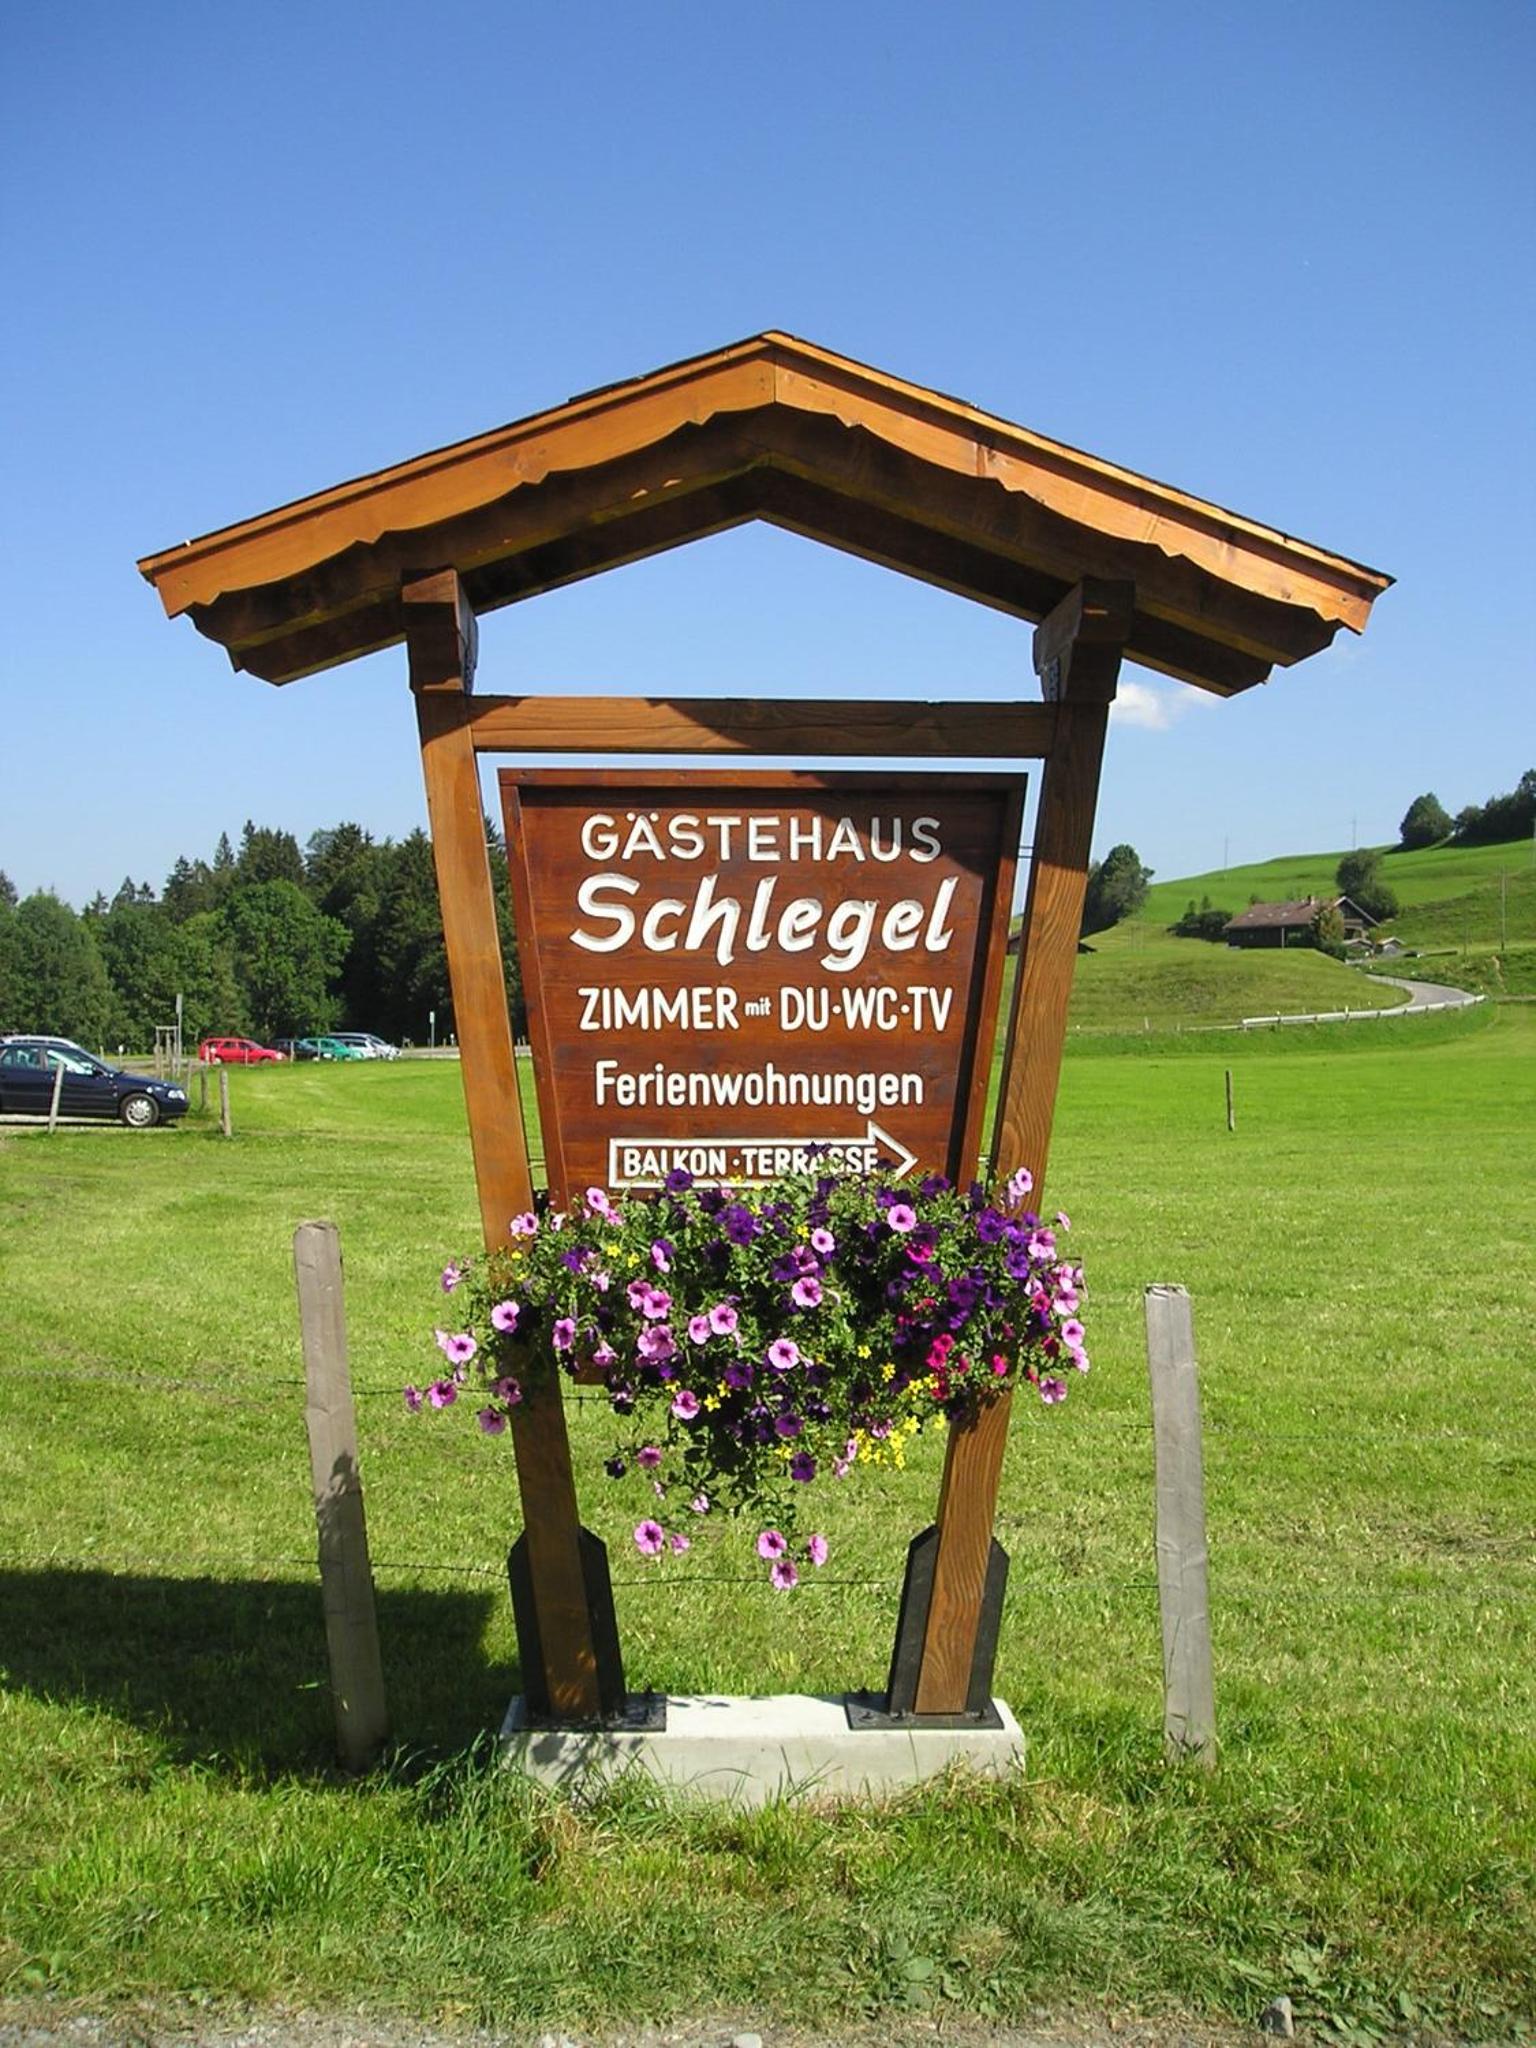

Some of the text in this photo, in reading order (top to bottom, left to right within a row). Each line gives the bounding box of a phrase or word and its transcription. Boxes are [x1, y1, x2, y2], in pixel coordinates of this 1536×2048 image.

[580, 812, 942, 864] GÄSTEHAUS
[569, 872, 960, 973] Schlegel
[577, 986, 740, 1031] ZIMMER
[744, 998, 772, 1017] mit
[595, 1060, 924, 1114] Ferienwohnungen
